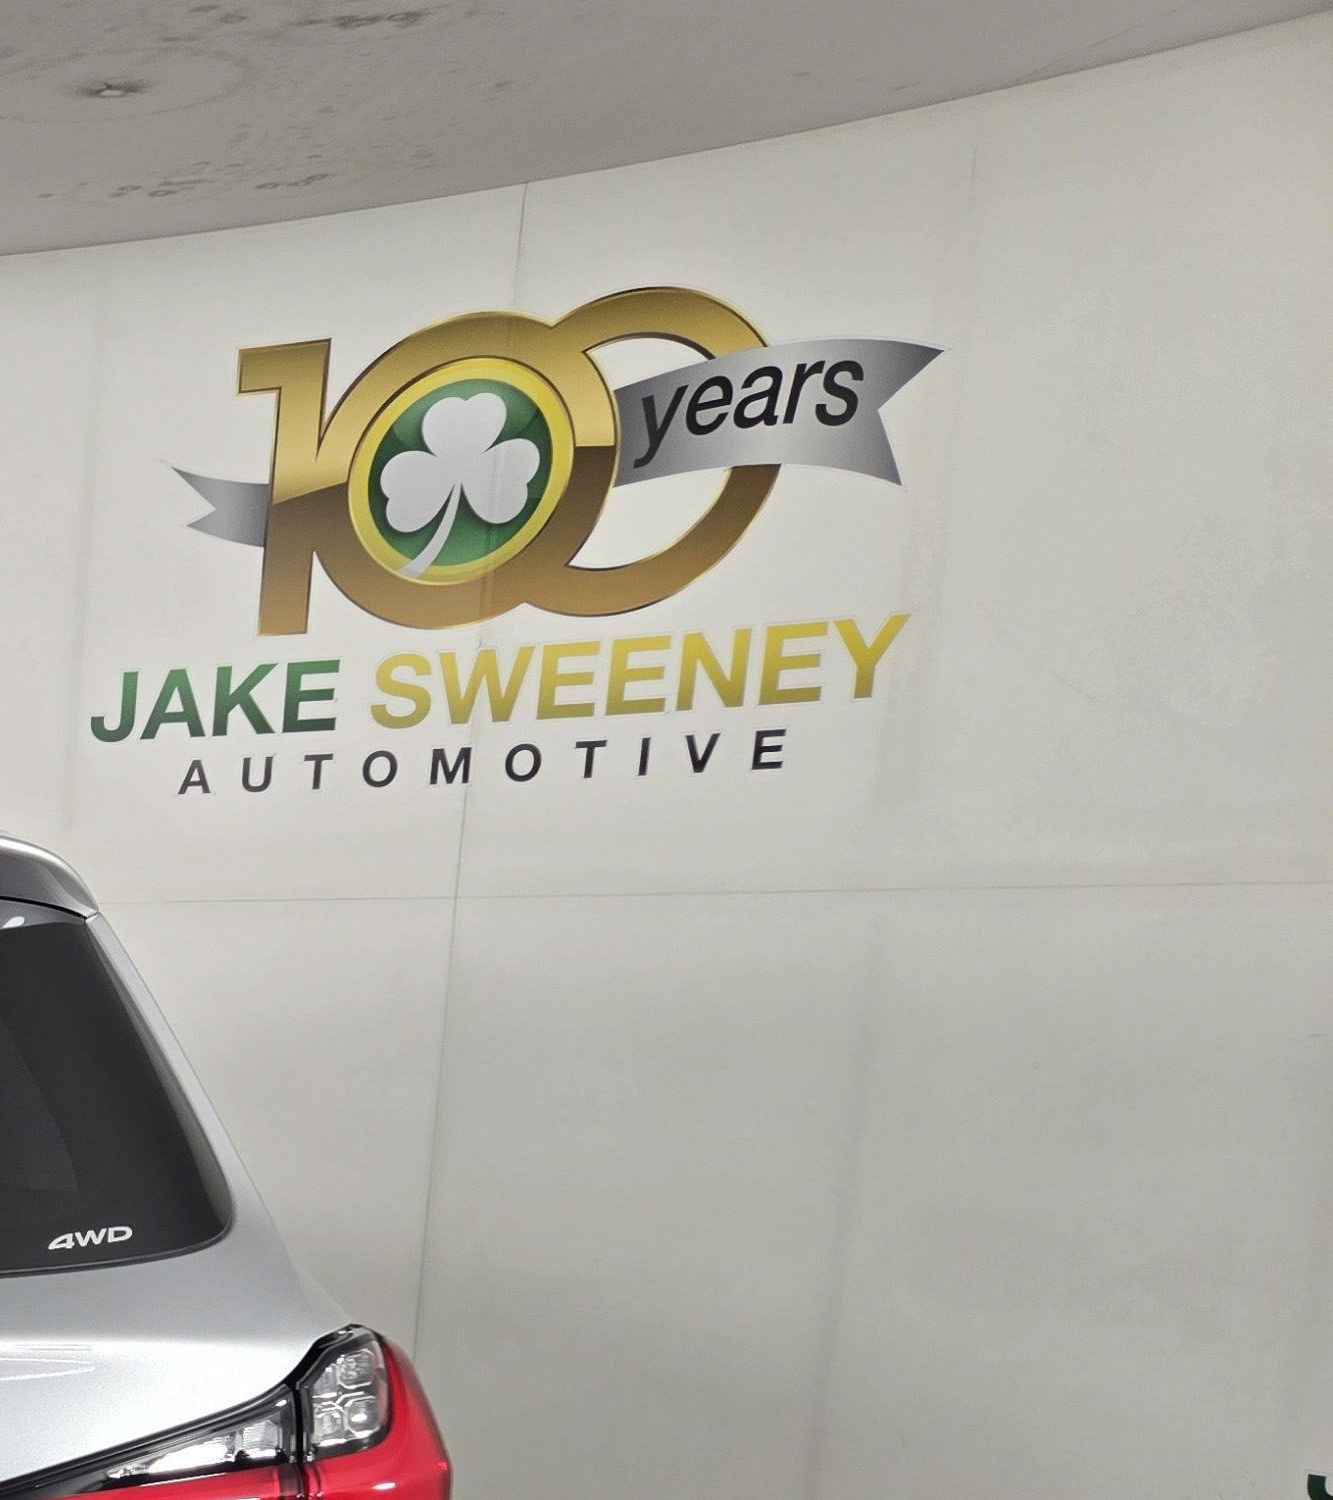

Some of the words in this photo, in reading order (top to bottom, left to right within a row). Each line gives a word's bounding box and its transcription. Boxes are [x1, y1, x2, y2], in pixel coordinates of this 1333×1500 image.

[237, 287, 779, 636] 100
[632, 360, 864, 468] years
[90, 659, 341, 743] JAKE
[370, 613, 911, 730] SWEENEY
[178, 728, 788, 795] AUTOMOTIVE
[48, 1226, 133, 1250] 4WD
